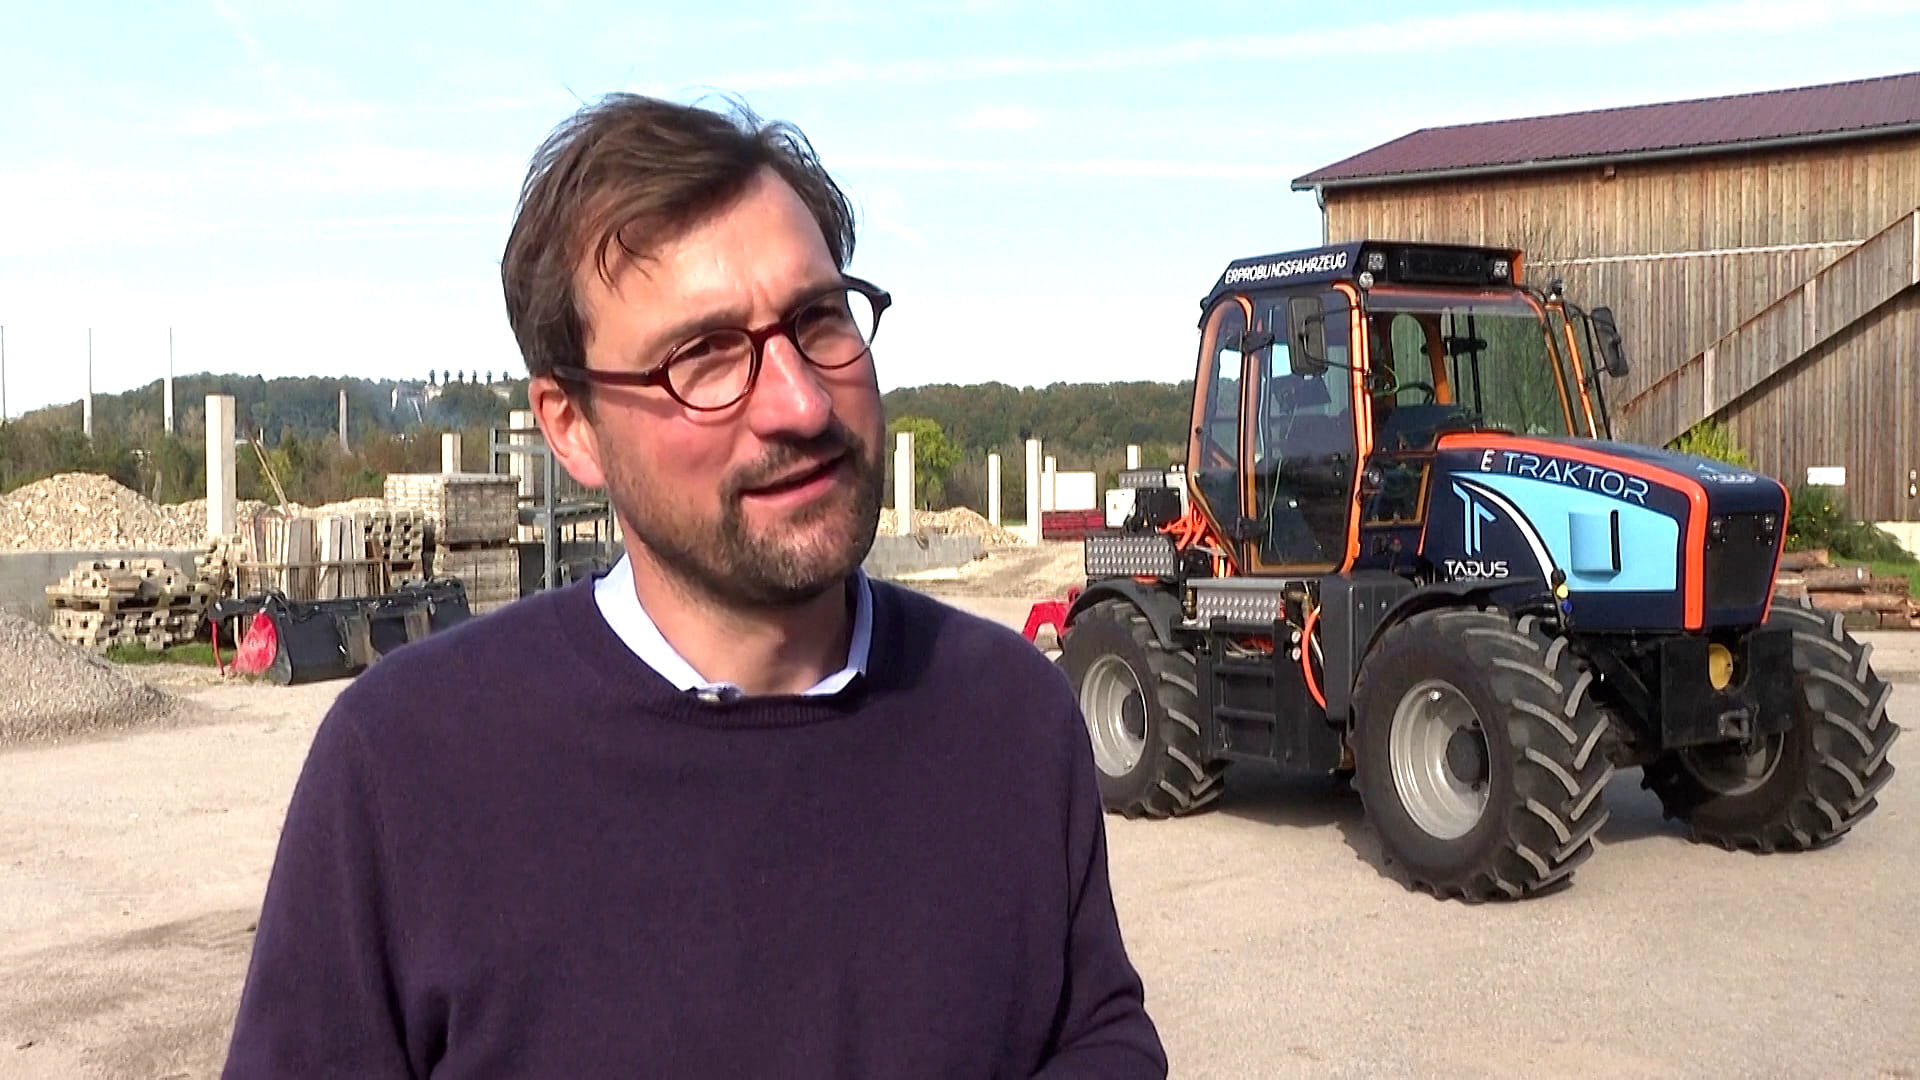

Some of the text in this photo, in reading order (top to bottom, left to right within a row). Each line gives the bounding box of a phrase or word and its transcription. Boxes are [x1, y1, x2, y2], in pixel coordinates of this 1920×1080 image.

[1224, 251, 1347, 285] ERPROBUNGSFAHRZEUG
[1480, 449, 1649, 505] E TRAKTOR
[1443, 560, 1509, 578] TADUS
